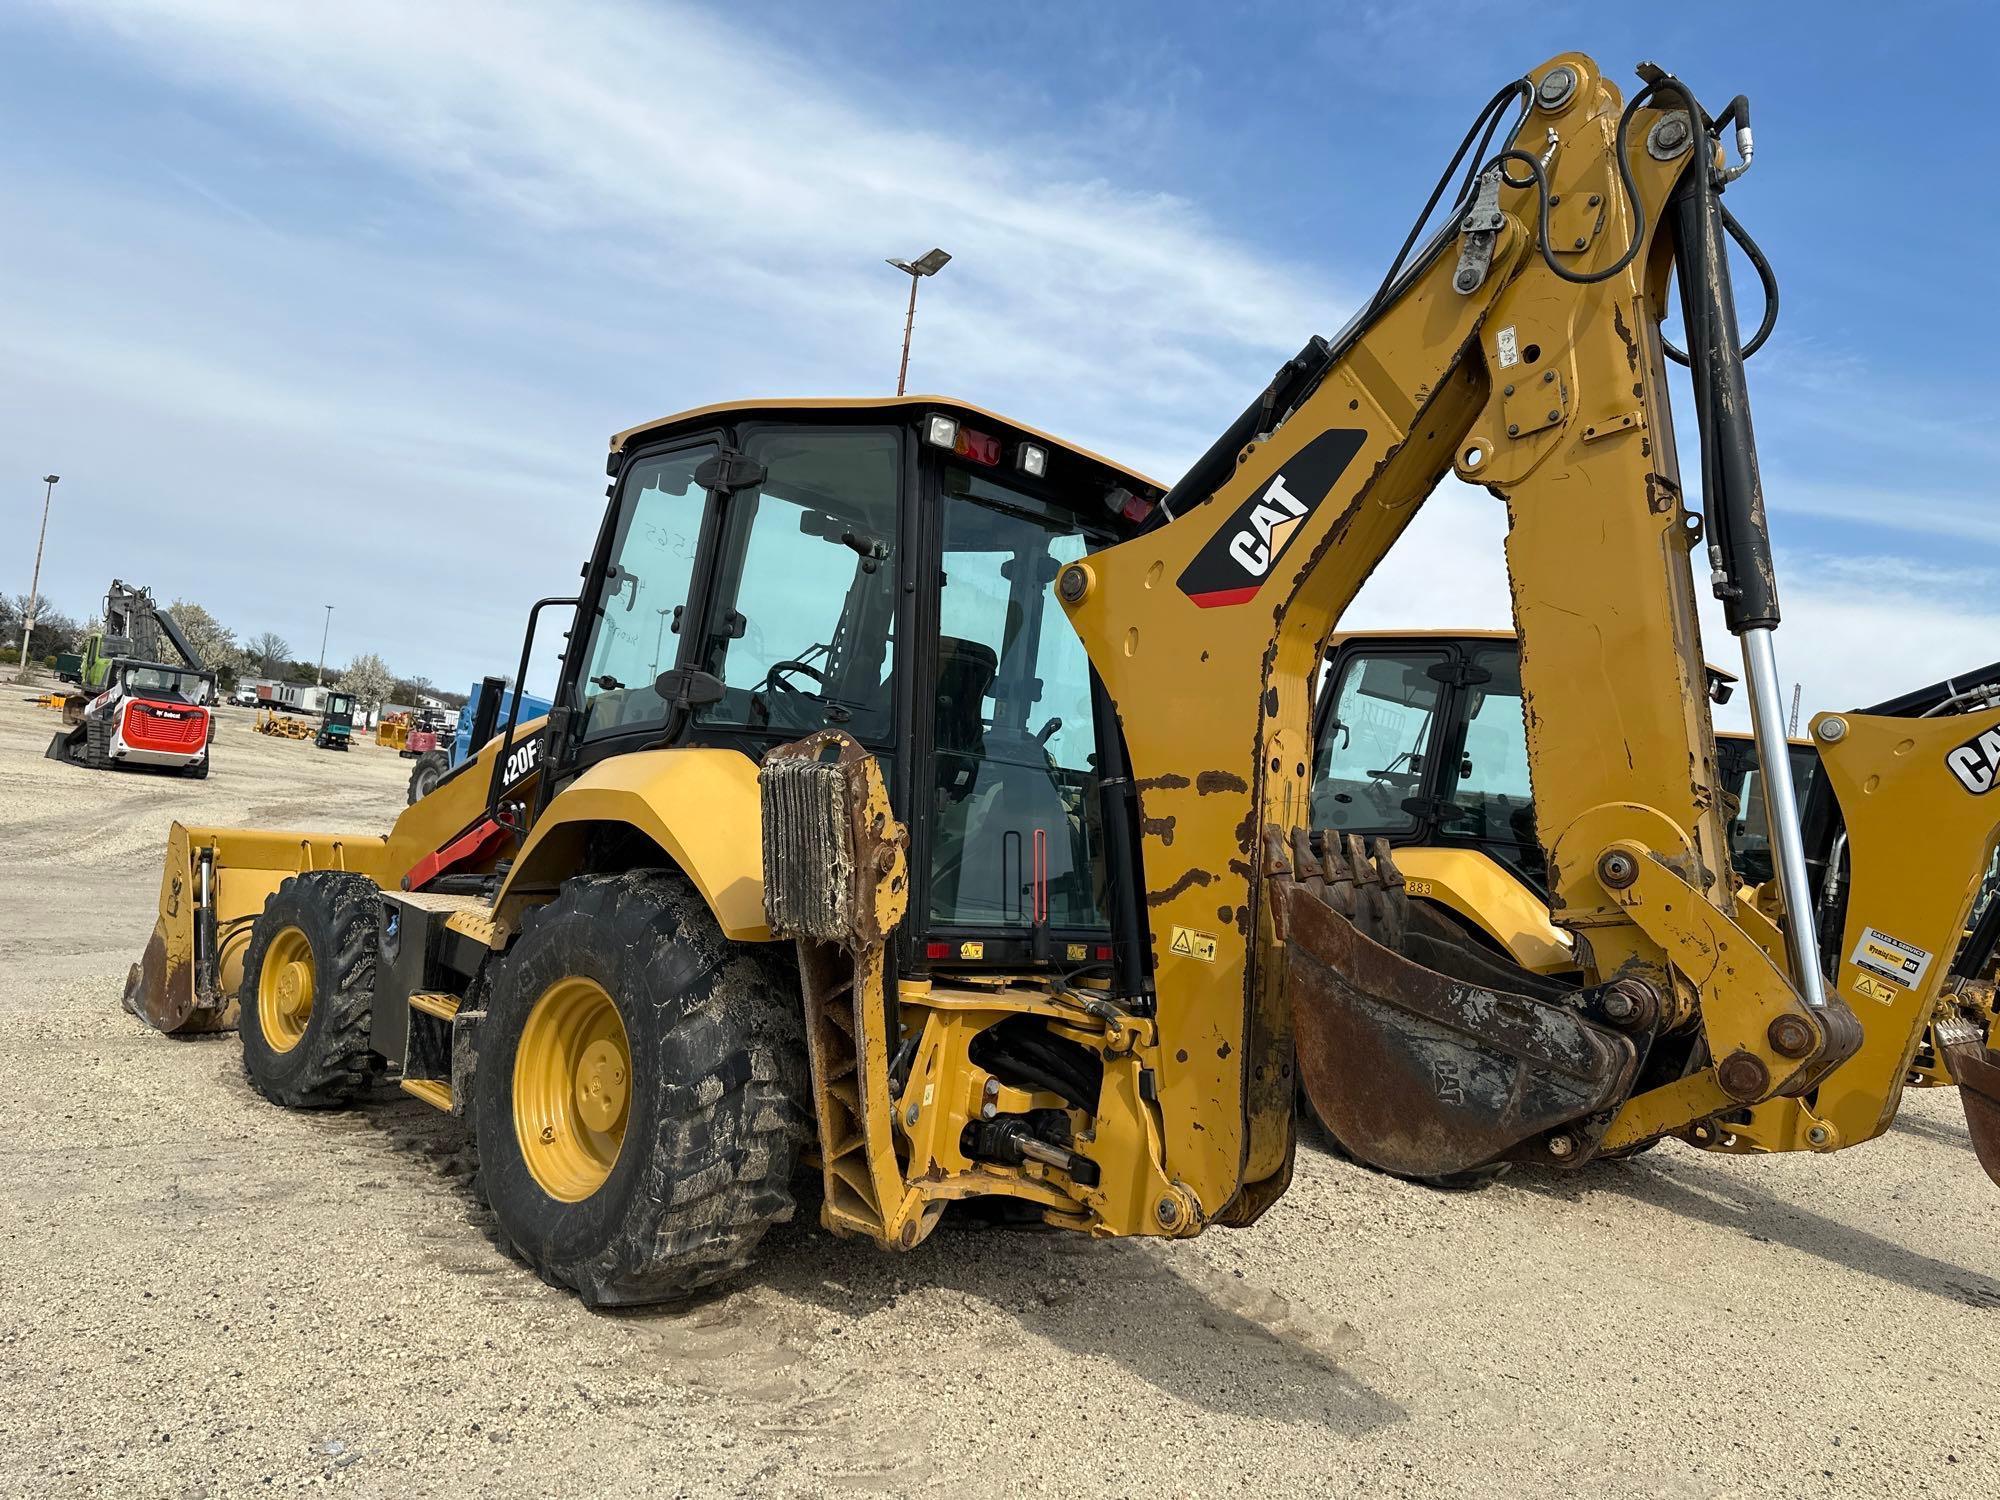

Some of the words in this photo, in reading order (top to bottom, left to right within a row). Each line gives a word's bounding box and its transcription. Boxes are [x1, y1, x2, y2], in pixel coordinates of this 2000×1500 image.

[1229, 475, 1309, 577] CAT
[1948, 726, 2000, 792] CA
[1904, 961, 1917, 971] CAT
[1434, 1060, 1464, 1105] CAT
